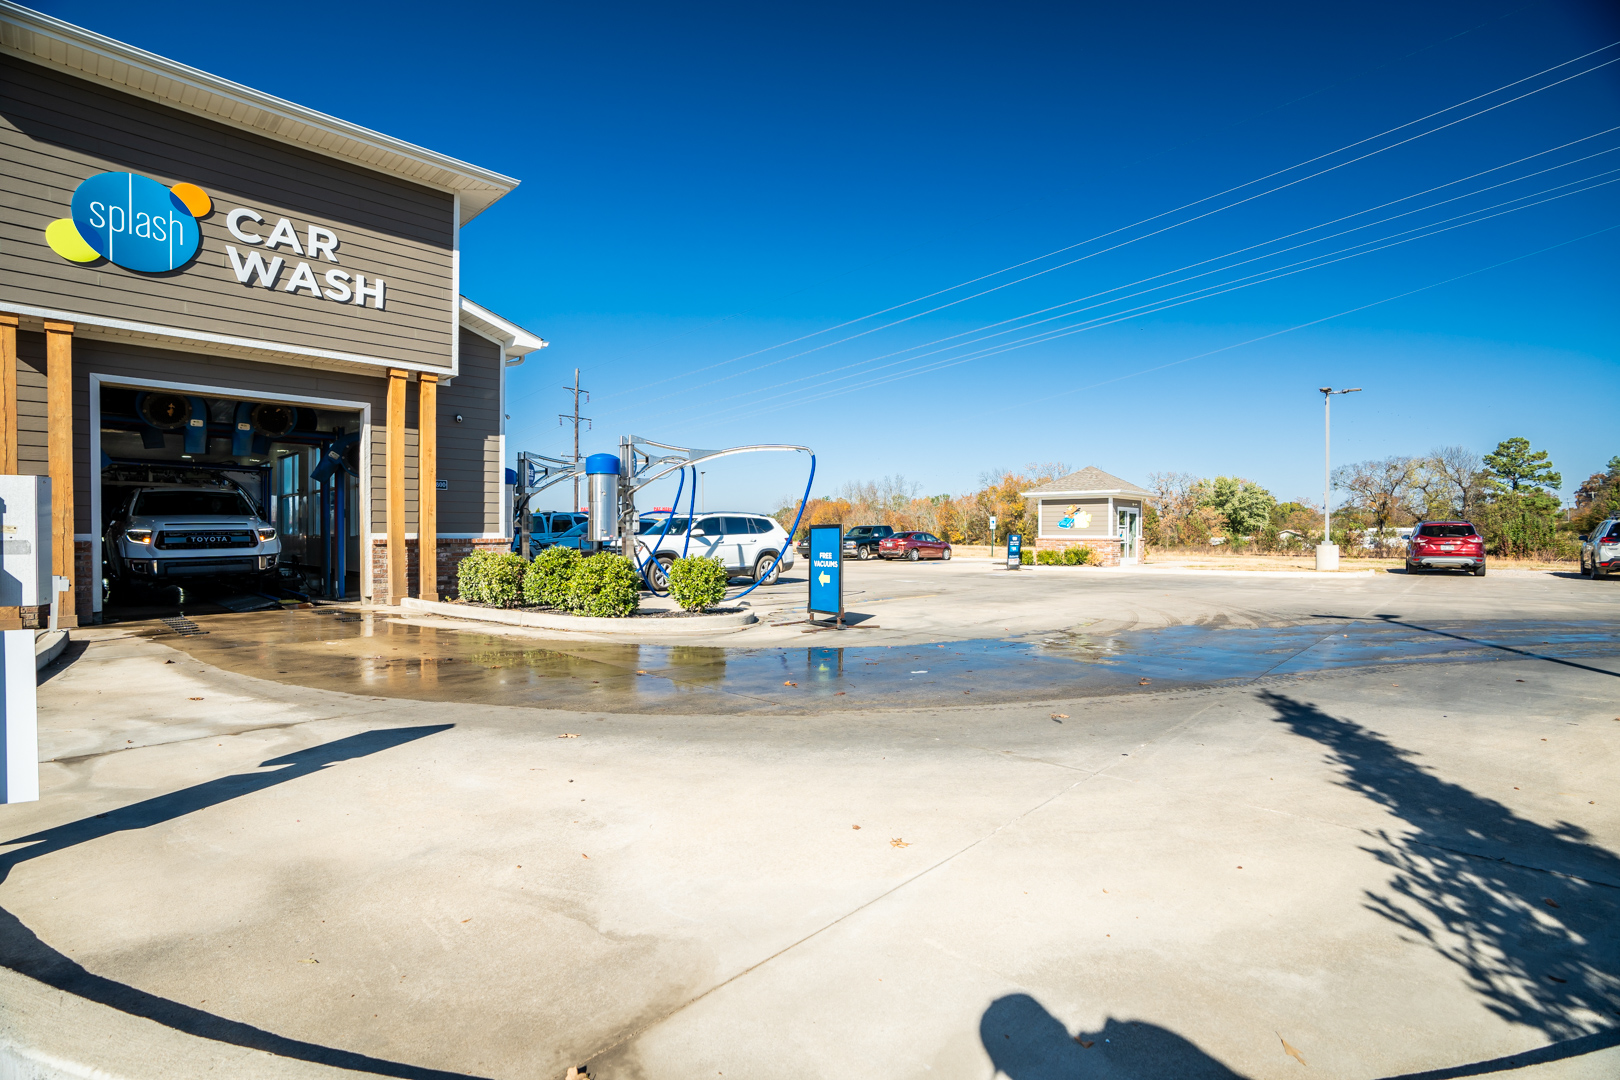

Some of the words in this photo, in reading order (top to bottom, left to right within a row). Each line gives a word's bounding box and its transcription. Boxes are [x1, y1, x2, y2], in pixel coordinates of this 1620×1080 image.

[89, 172, 184, 270] splash
[225, 207, 339, 263] CAR
[225, 245, 386, 311] WASH
